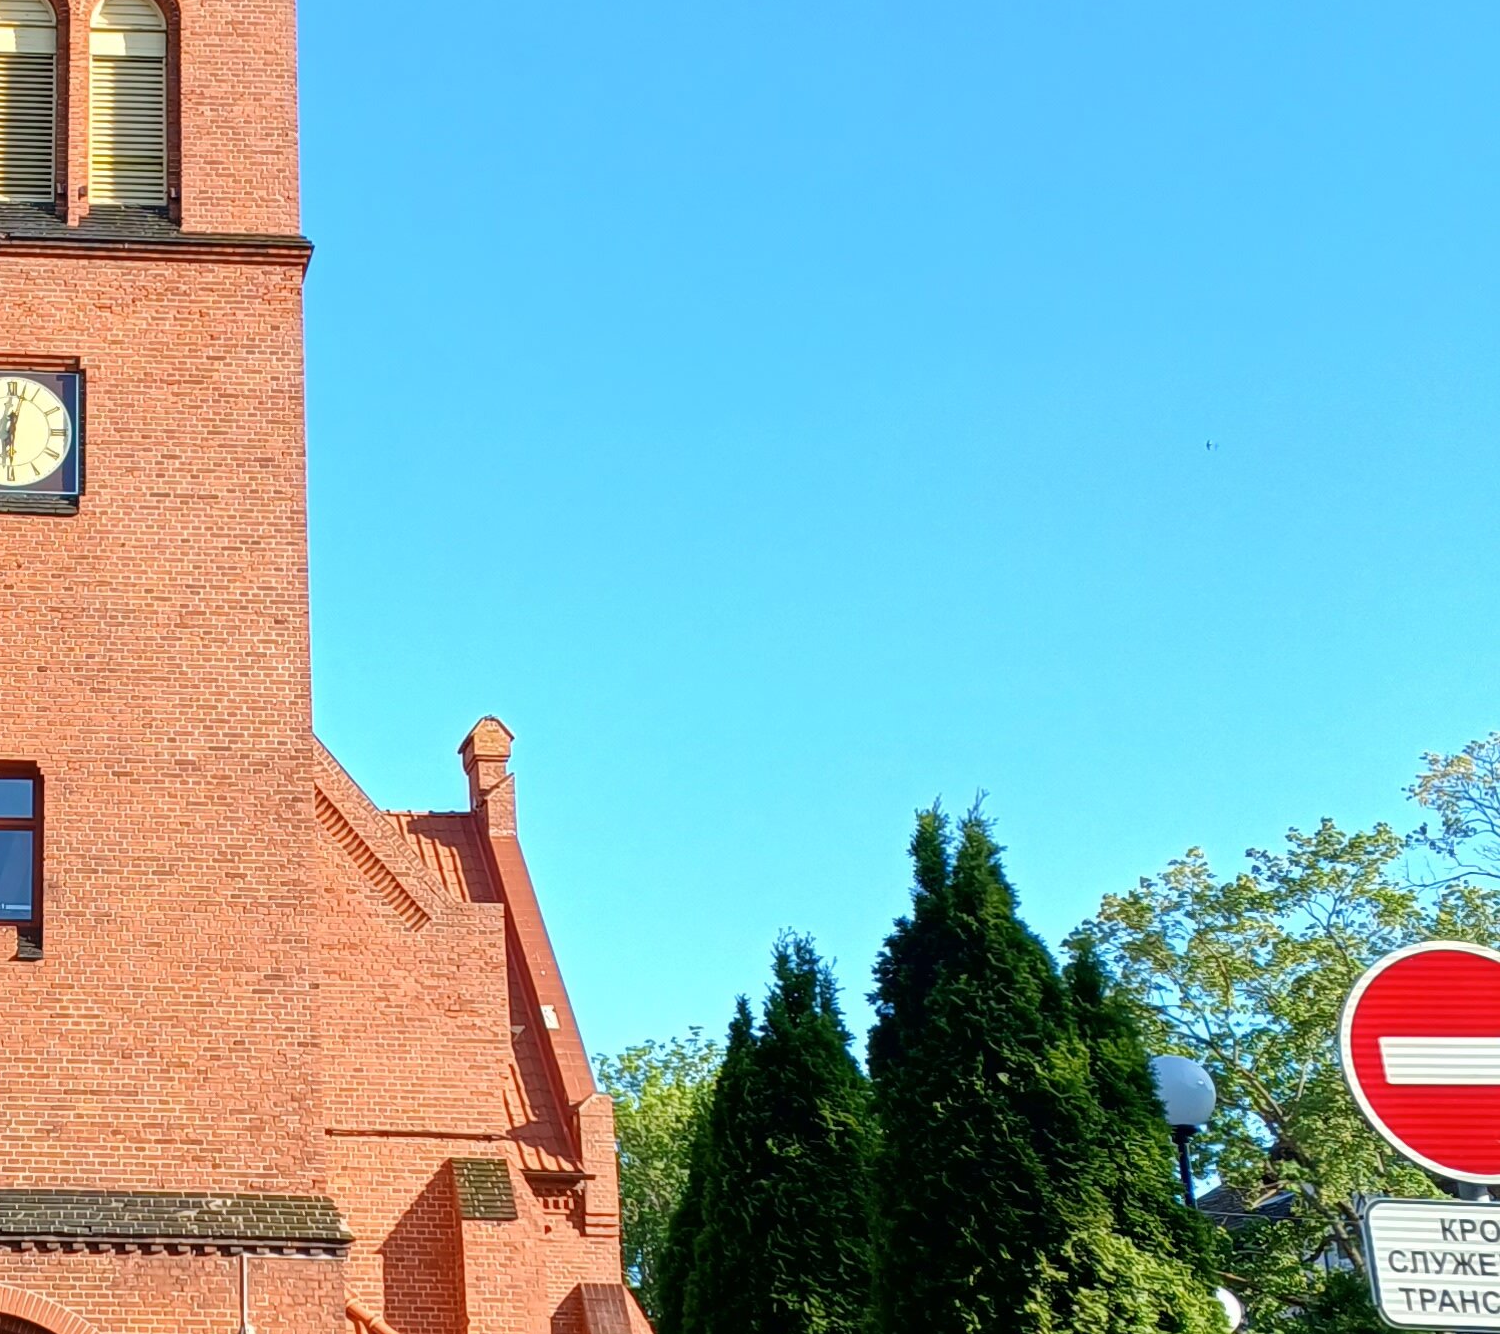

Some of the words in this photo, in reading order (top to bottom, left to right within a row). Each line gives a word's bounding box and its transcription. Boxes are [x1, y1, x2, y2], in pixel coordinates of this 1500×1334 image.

[1440, 1218, 1500, 1243] КРО
[1388, 1250, 1500, 1277] СЛУЖЕ
[1398, 1287, 1500, 1315] ТРАНС
